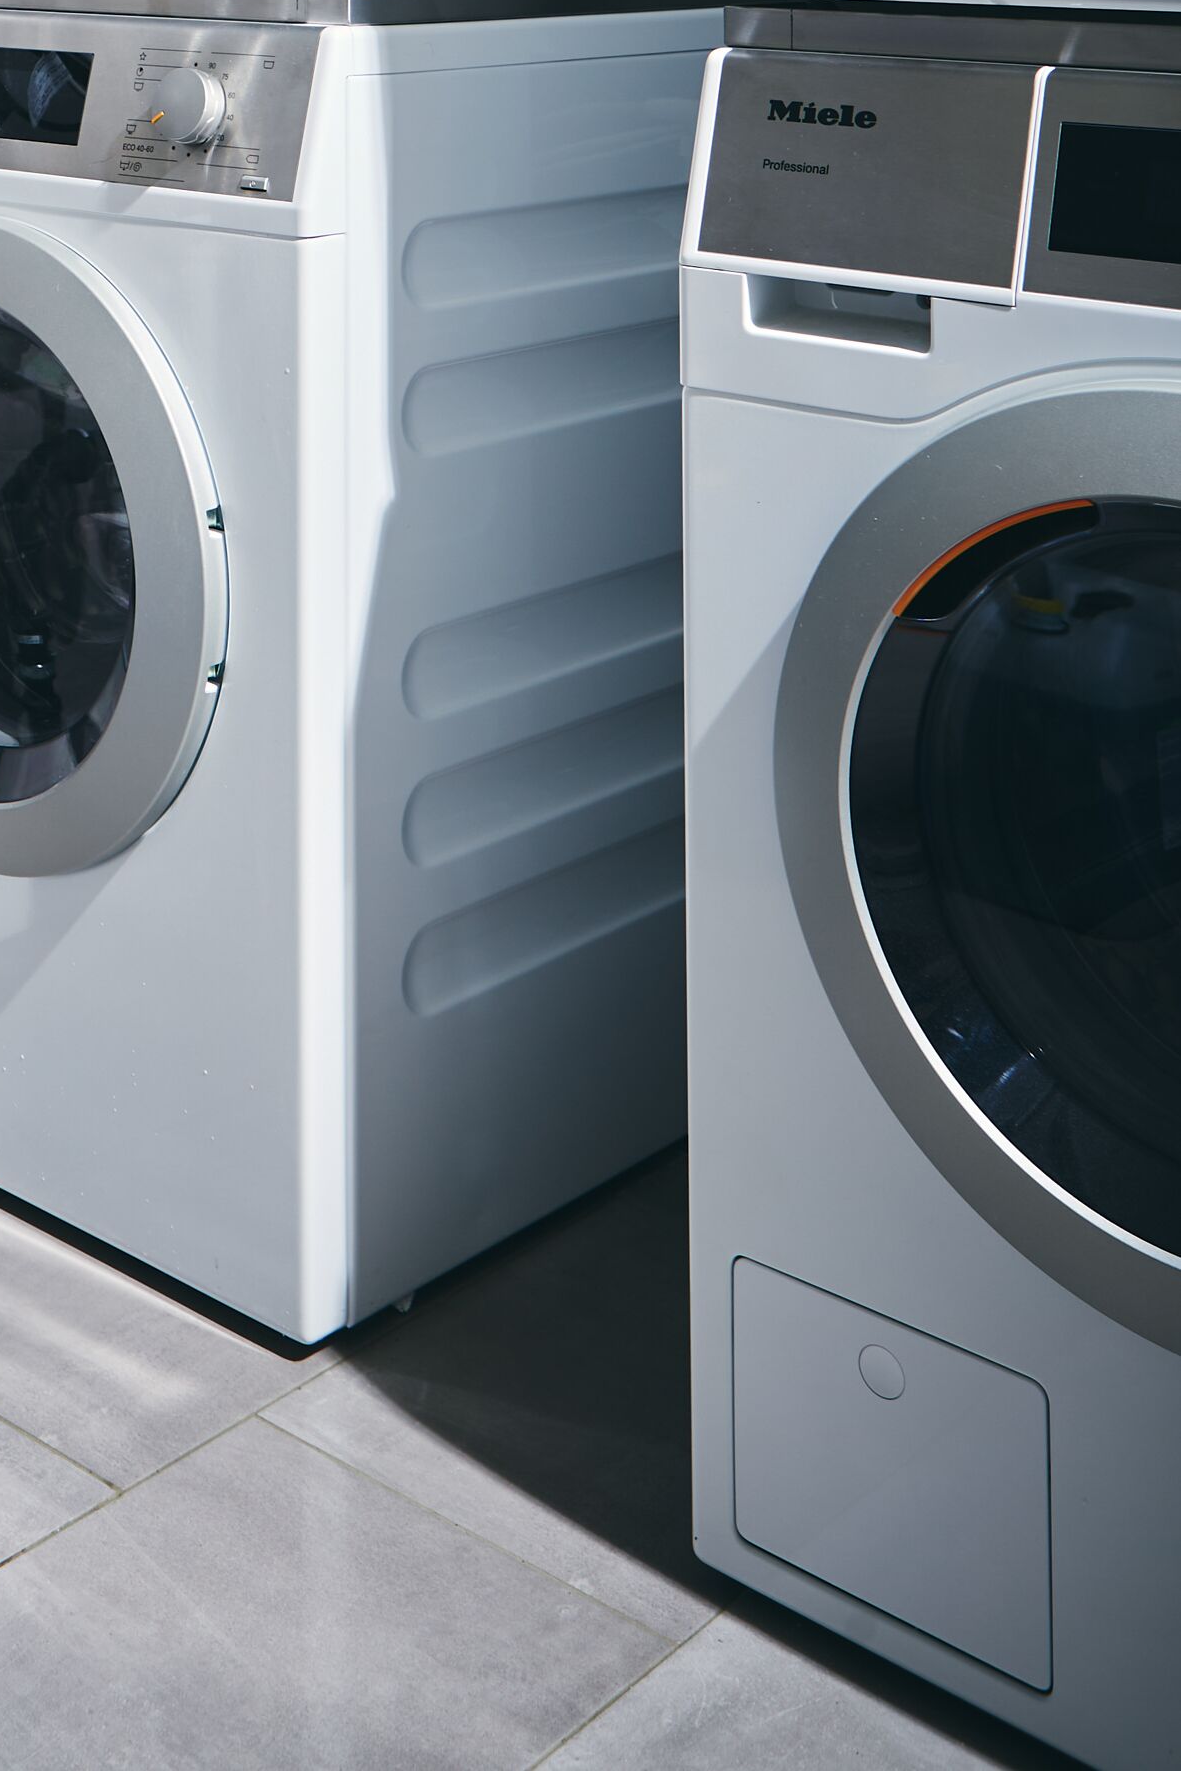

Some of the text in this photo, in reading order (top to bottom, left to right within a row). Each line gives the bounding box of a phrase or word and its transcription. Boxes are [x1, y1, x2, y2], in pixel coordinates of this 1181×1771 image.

[221, 73, 229, 81] 75
[767, 99, 878, 129] Miele
[122, 143, 154, 153] ECO 40-60
[762, 158, 830, 176] Professional
